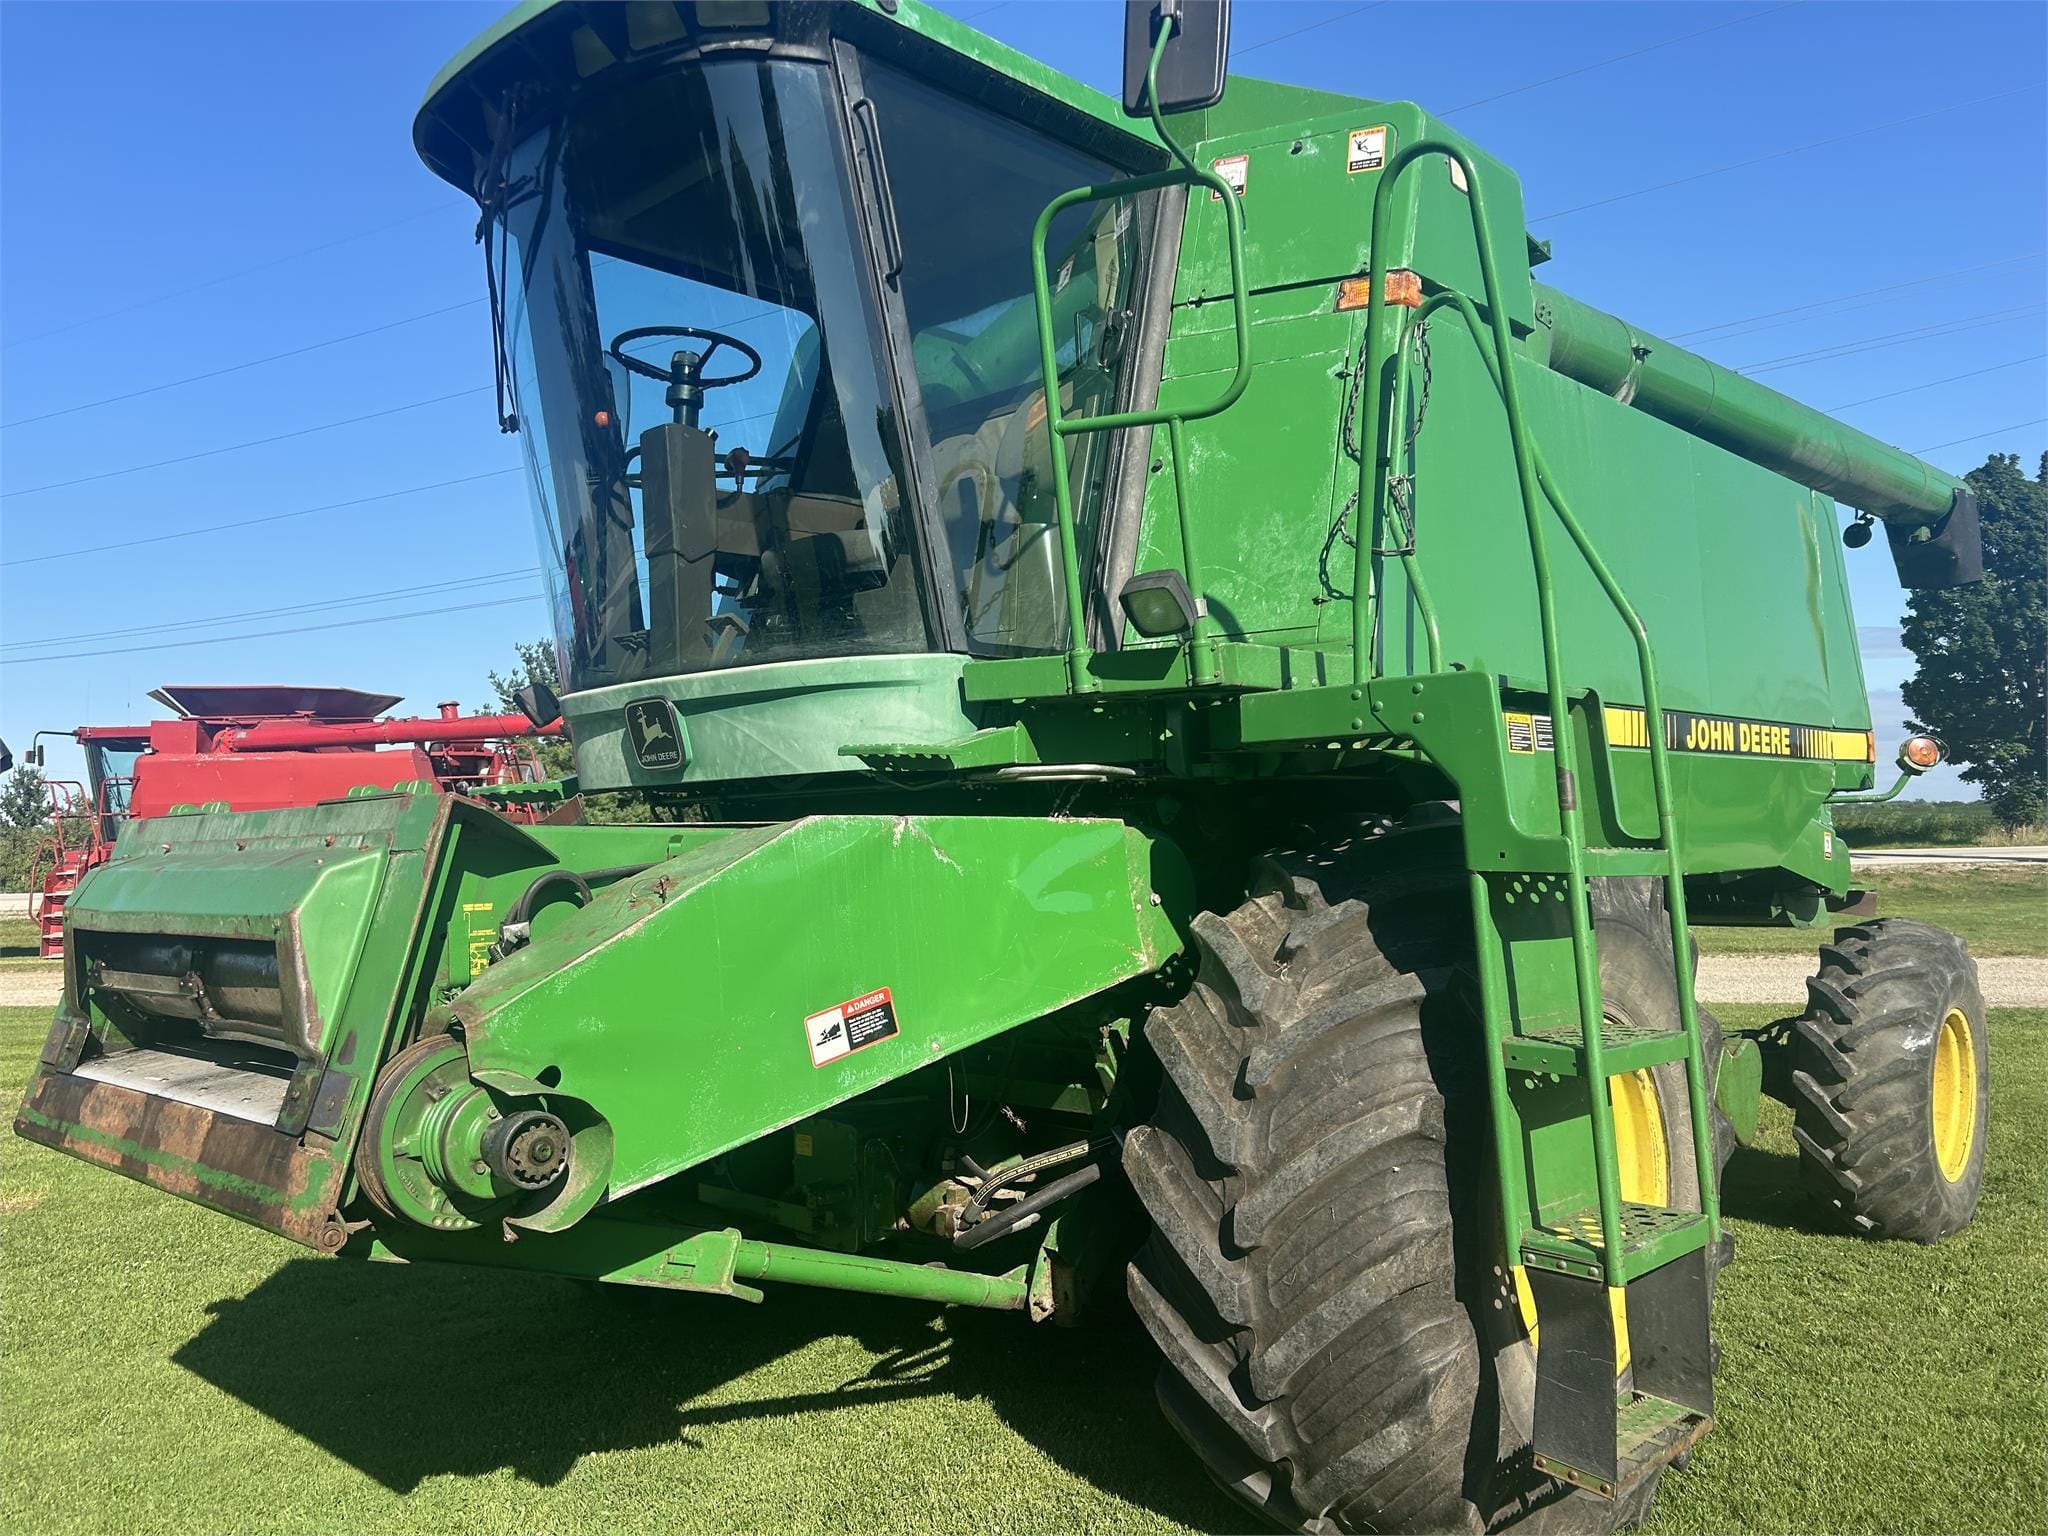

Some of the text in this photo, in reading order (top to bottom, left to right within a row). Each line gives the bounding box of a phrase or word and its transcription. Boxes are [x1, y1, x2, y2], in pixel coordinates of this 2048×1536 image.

[1686, 718, 1791, 756] JOHN DEERE
[641, 751, 678, 764] JOHN DEERE
[853, 992, 885, 1010] DANGER
